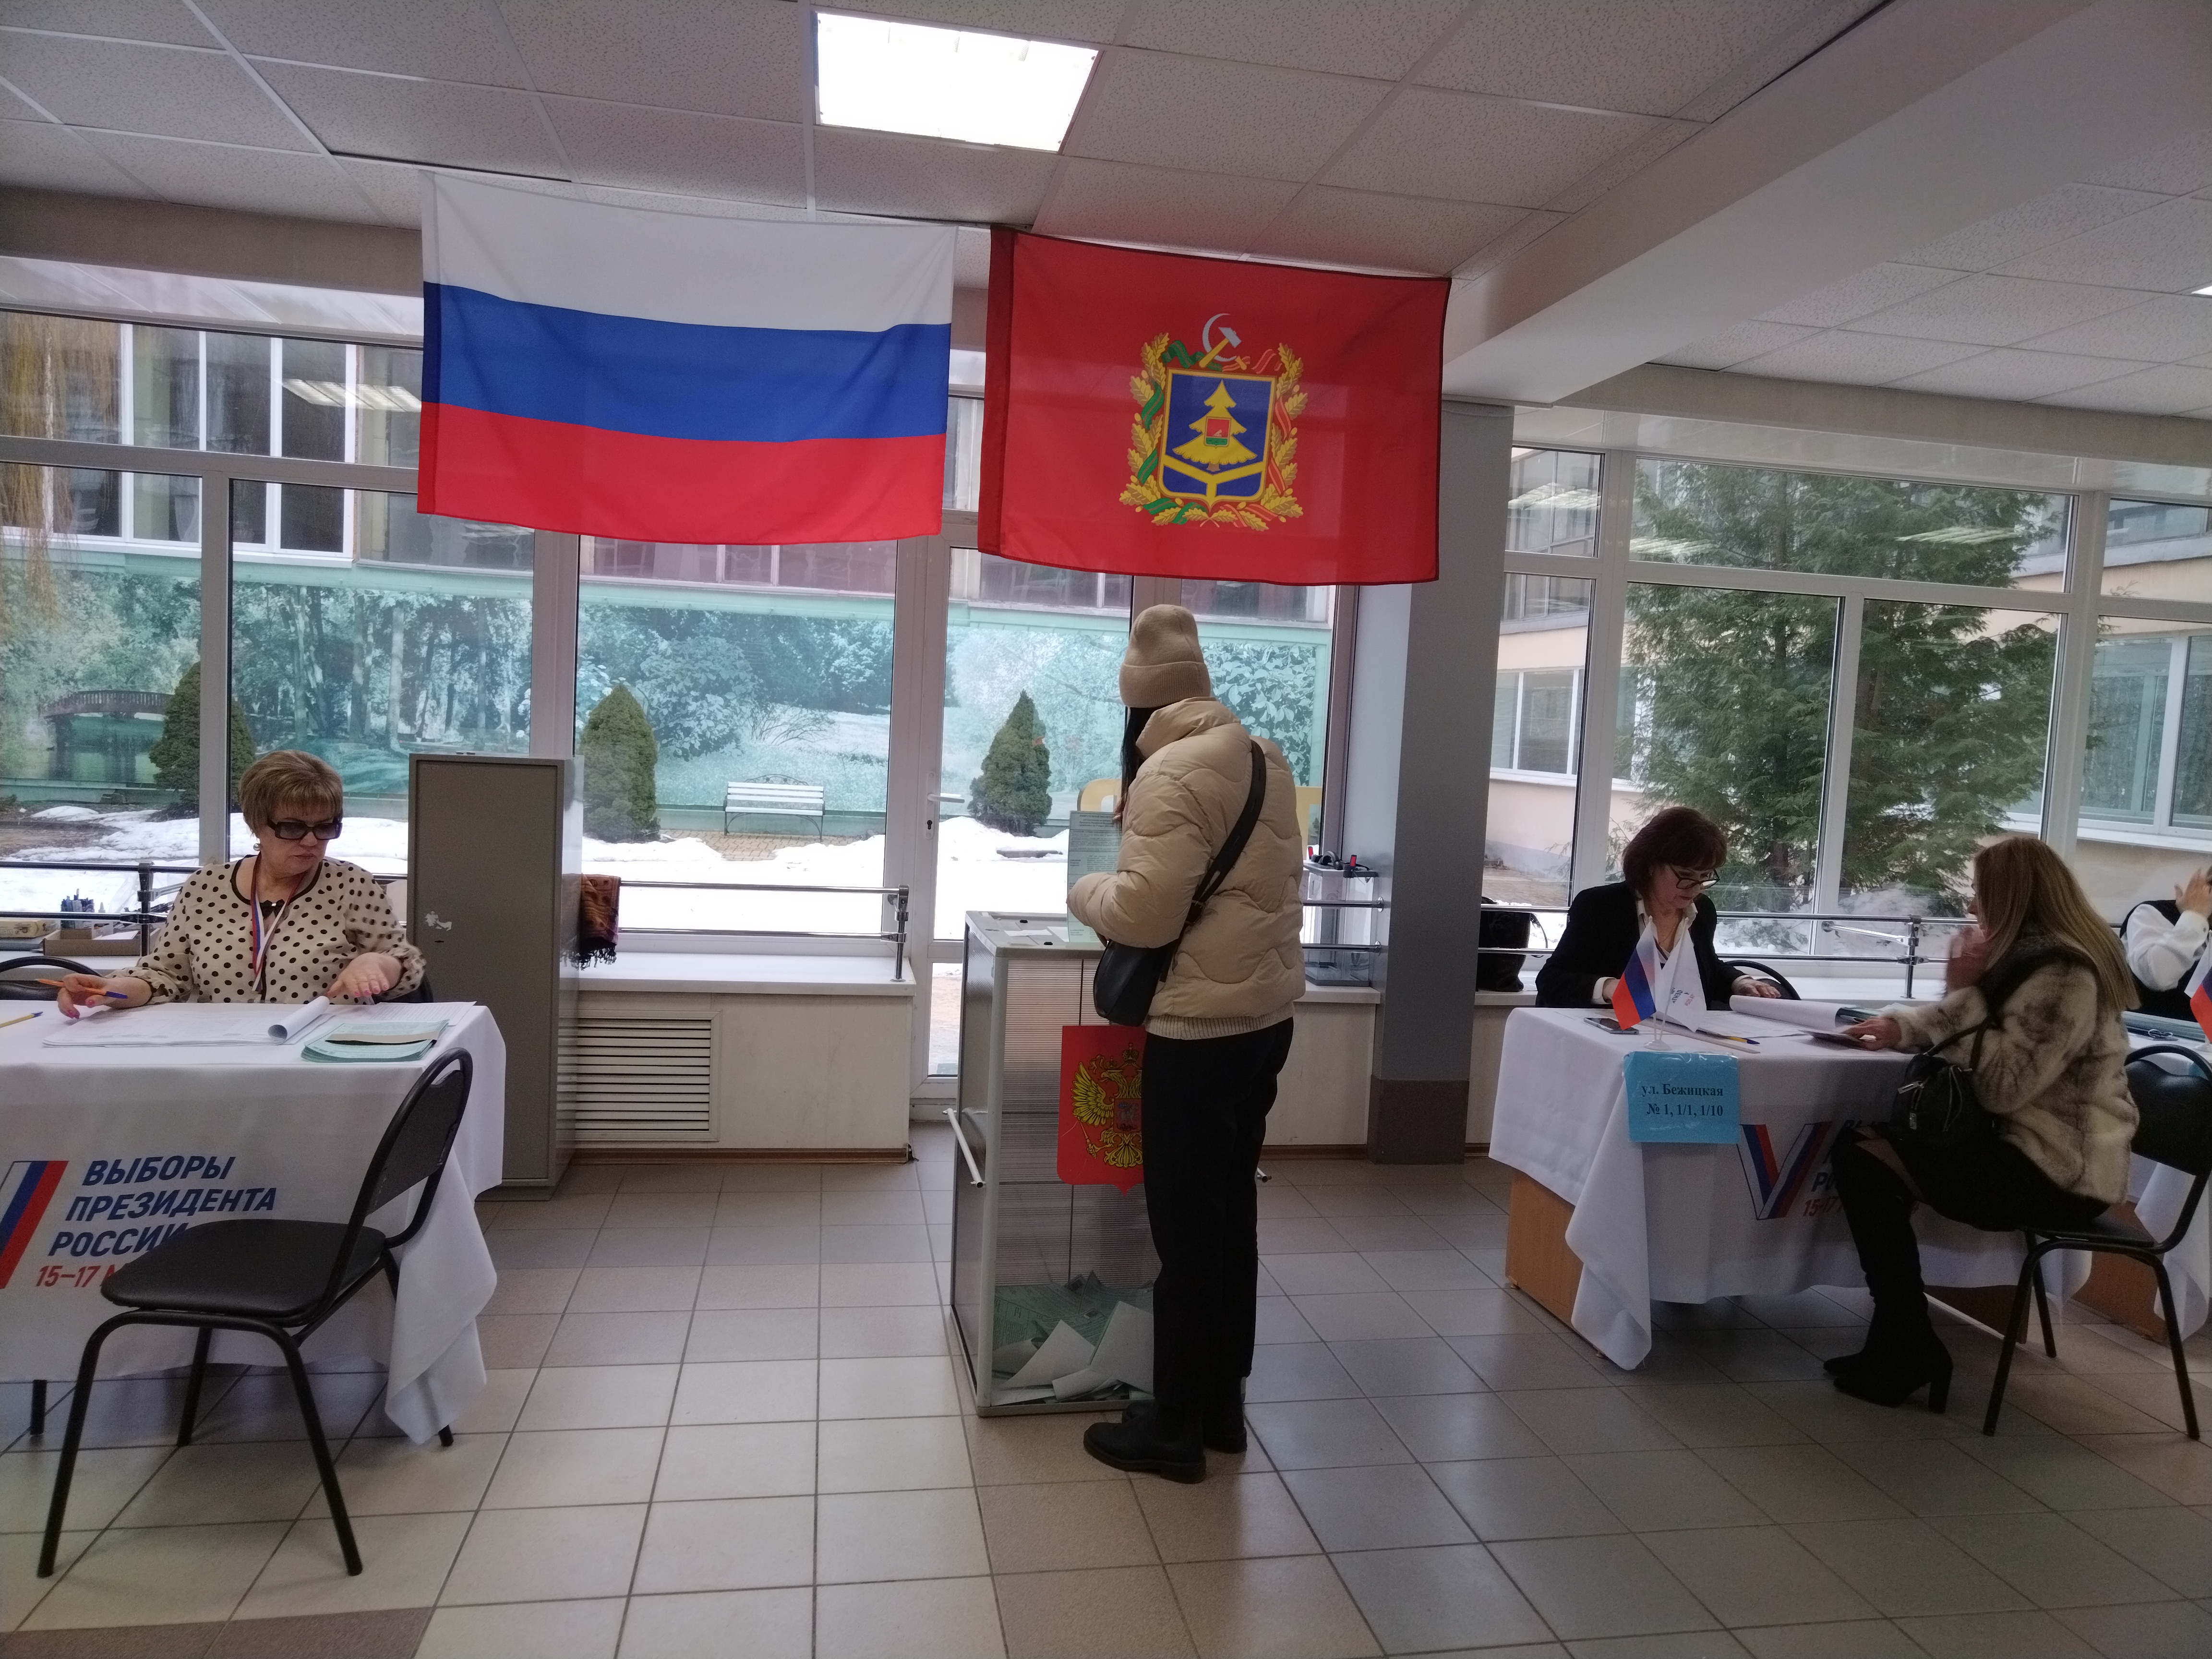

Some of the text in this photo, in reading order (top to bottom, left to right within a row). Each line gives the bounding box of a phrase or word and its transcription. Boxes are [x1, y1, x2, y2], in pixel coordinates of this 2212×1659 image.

[1641, 1083, 1724, 1097] ул. Бежицкая
[1647, 1103, 1723, 1118] № 1, 1/1, 1/10
[82, 1155, 236, 1186] ВЫБОРЫ
[65, 1187, 277, 1222] ПРЕЗИДЕНТА
